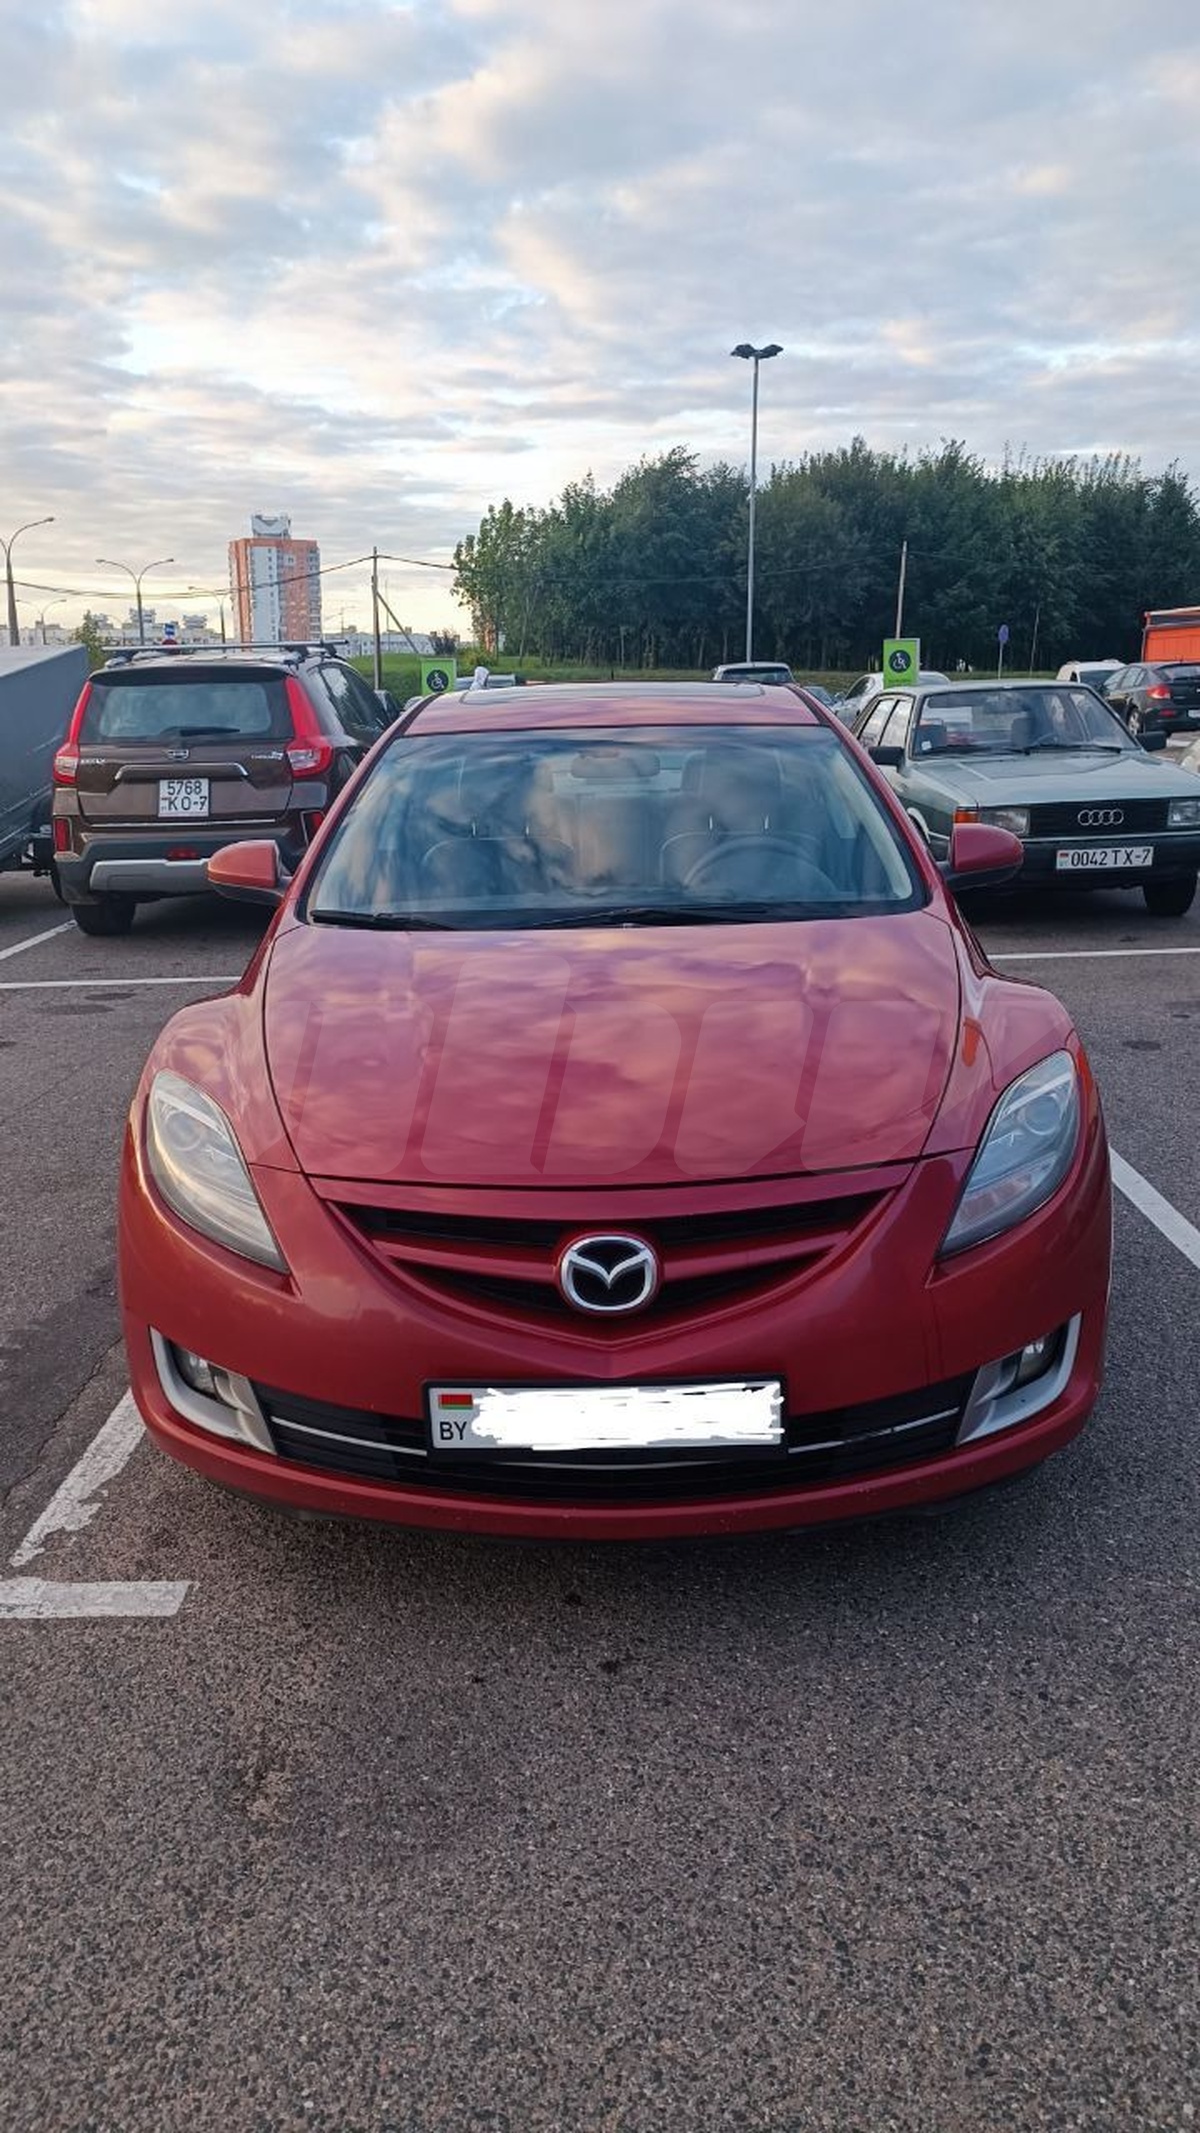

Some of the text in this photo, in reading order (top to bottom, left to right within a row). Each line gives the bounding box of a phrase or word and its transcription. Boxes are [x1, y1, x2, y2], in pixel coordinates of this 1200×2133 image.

[167, 780, 203, 796] 5768
[1071, 850, 1108, 868] 0042
[438, 1420, 468, 1441] BY
